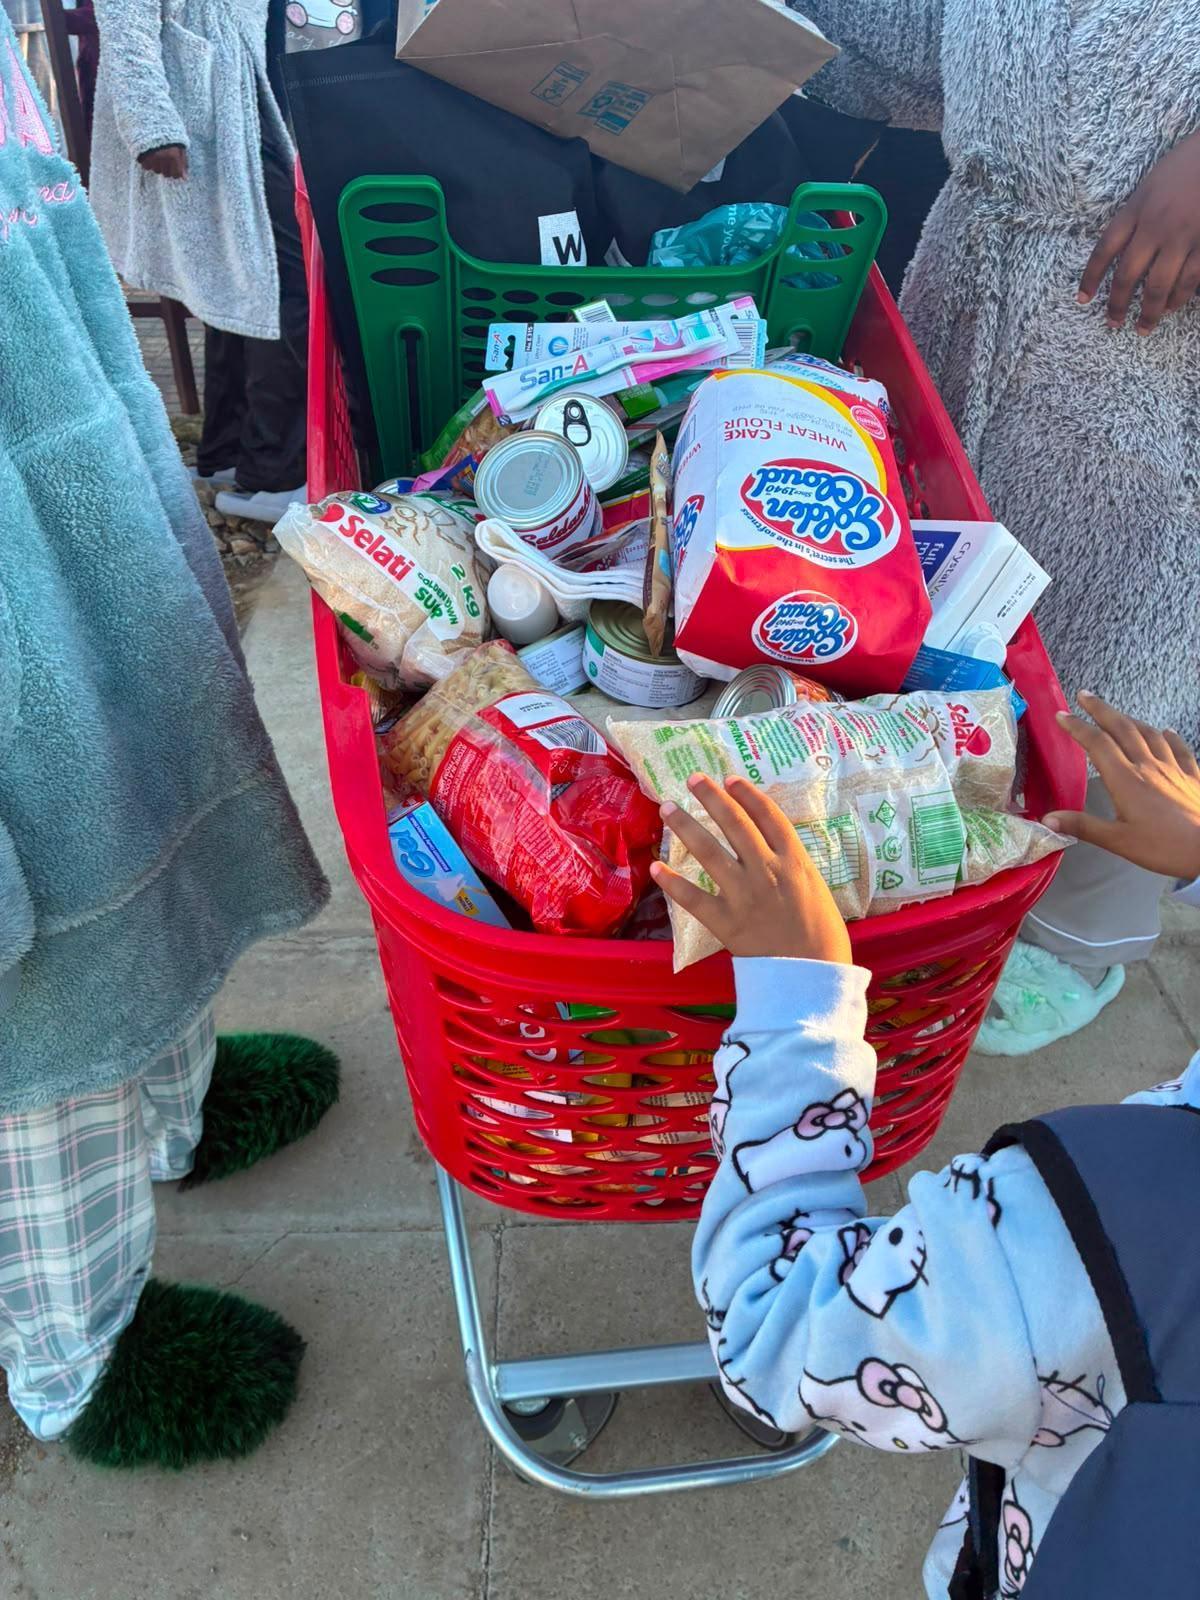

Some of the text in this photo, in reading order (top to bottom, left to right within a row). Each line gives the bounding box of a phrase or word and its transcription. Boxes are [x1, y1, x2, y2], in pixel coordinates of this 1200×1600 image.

[552, 230, 582, 265] W
[519, 354, 590, 391] San-A
[724, 417, 783, 431] FLOUR
[724, 429, 771, 441] CAKE
[787, 424, 848, 451] WHEAT
[751, 468, 864, 509] Cloud
[765, 484, 794, 495] 1940
[766, 496, 882, 551] Golden
[338, 514, 416, 582] Selati
[776, 535, 794, 547] the
[924, 541, 944, 566] full
[451, 563, 467, 581] 2
[838, 553, 856, 565] The
[765, 604, 840, 629] Cloud
[769, 618, 849, 656] Golden
[726, 720, 765, 785] SPRINKLE JOY
